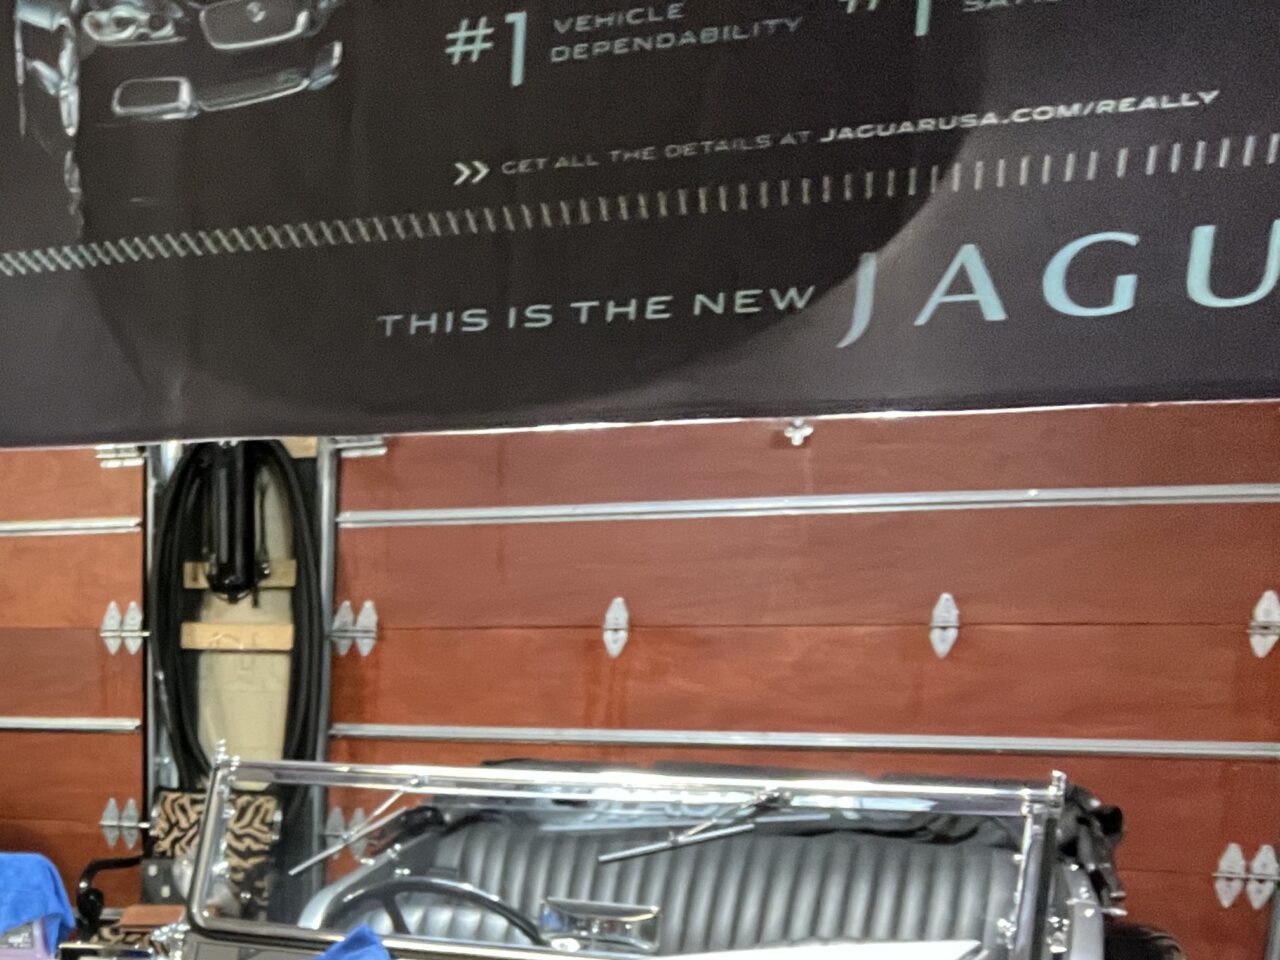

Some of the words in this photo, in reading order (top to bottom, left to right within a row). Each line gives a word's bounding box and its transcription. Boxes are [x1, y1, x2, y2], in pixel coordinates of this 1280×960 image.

[444, 11, 528, 87] #1
[550, 16, 804, 63] DEPENDABILITY
[552, 2, 686, 34] VEHICLE
[501, 157, 548, 175] GET
[554, 153, 600, 169] ALL
[608, 146, 657, 162] THE
[664, 133, 772, 159] DETAILS
[779, 130, 812, 145] AT
[819, 89, 1220, 143] JAGUARUSA.COM/REALLY
[377, 307, 489, 337] THIS
[507, 304, 553, 330] IS
[570, 295, 675, 324] THE
[692, 285, 816, 316] NEW
[835, 218, 1280, 349] JAGU
